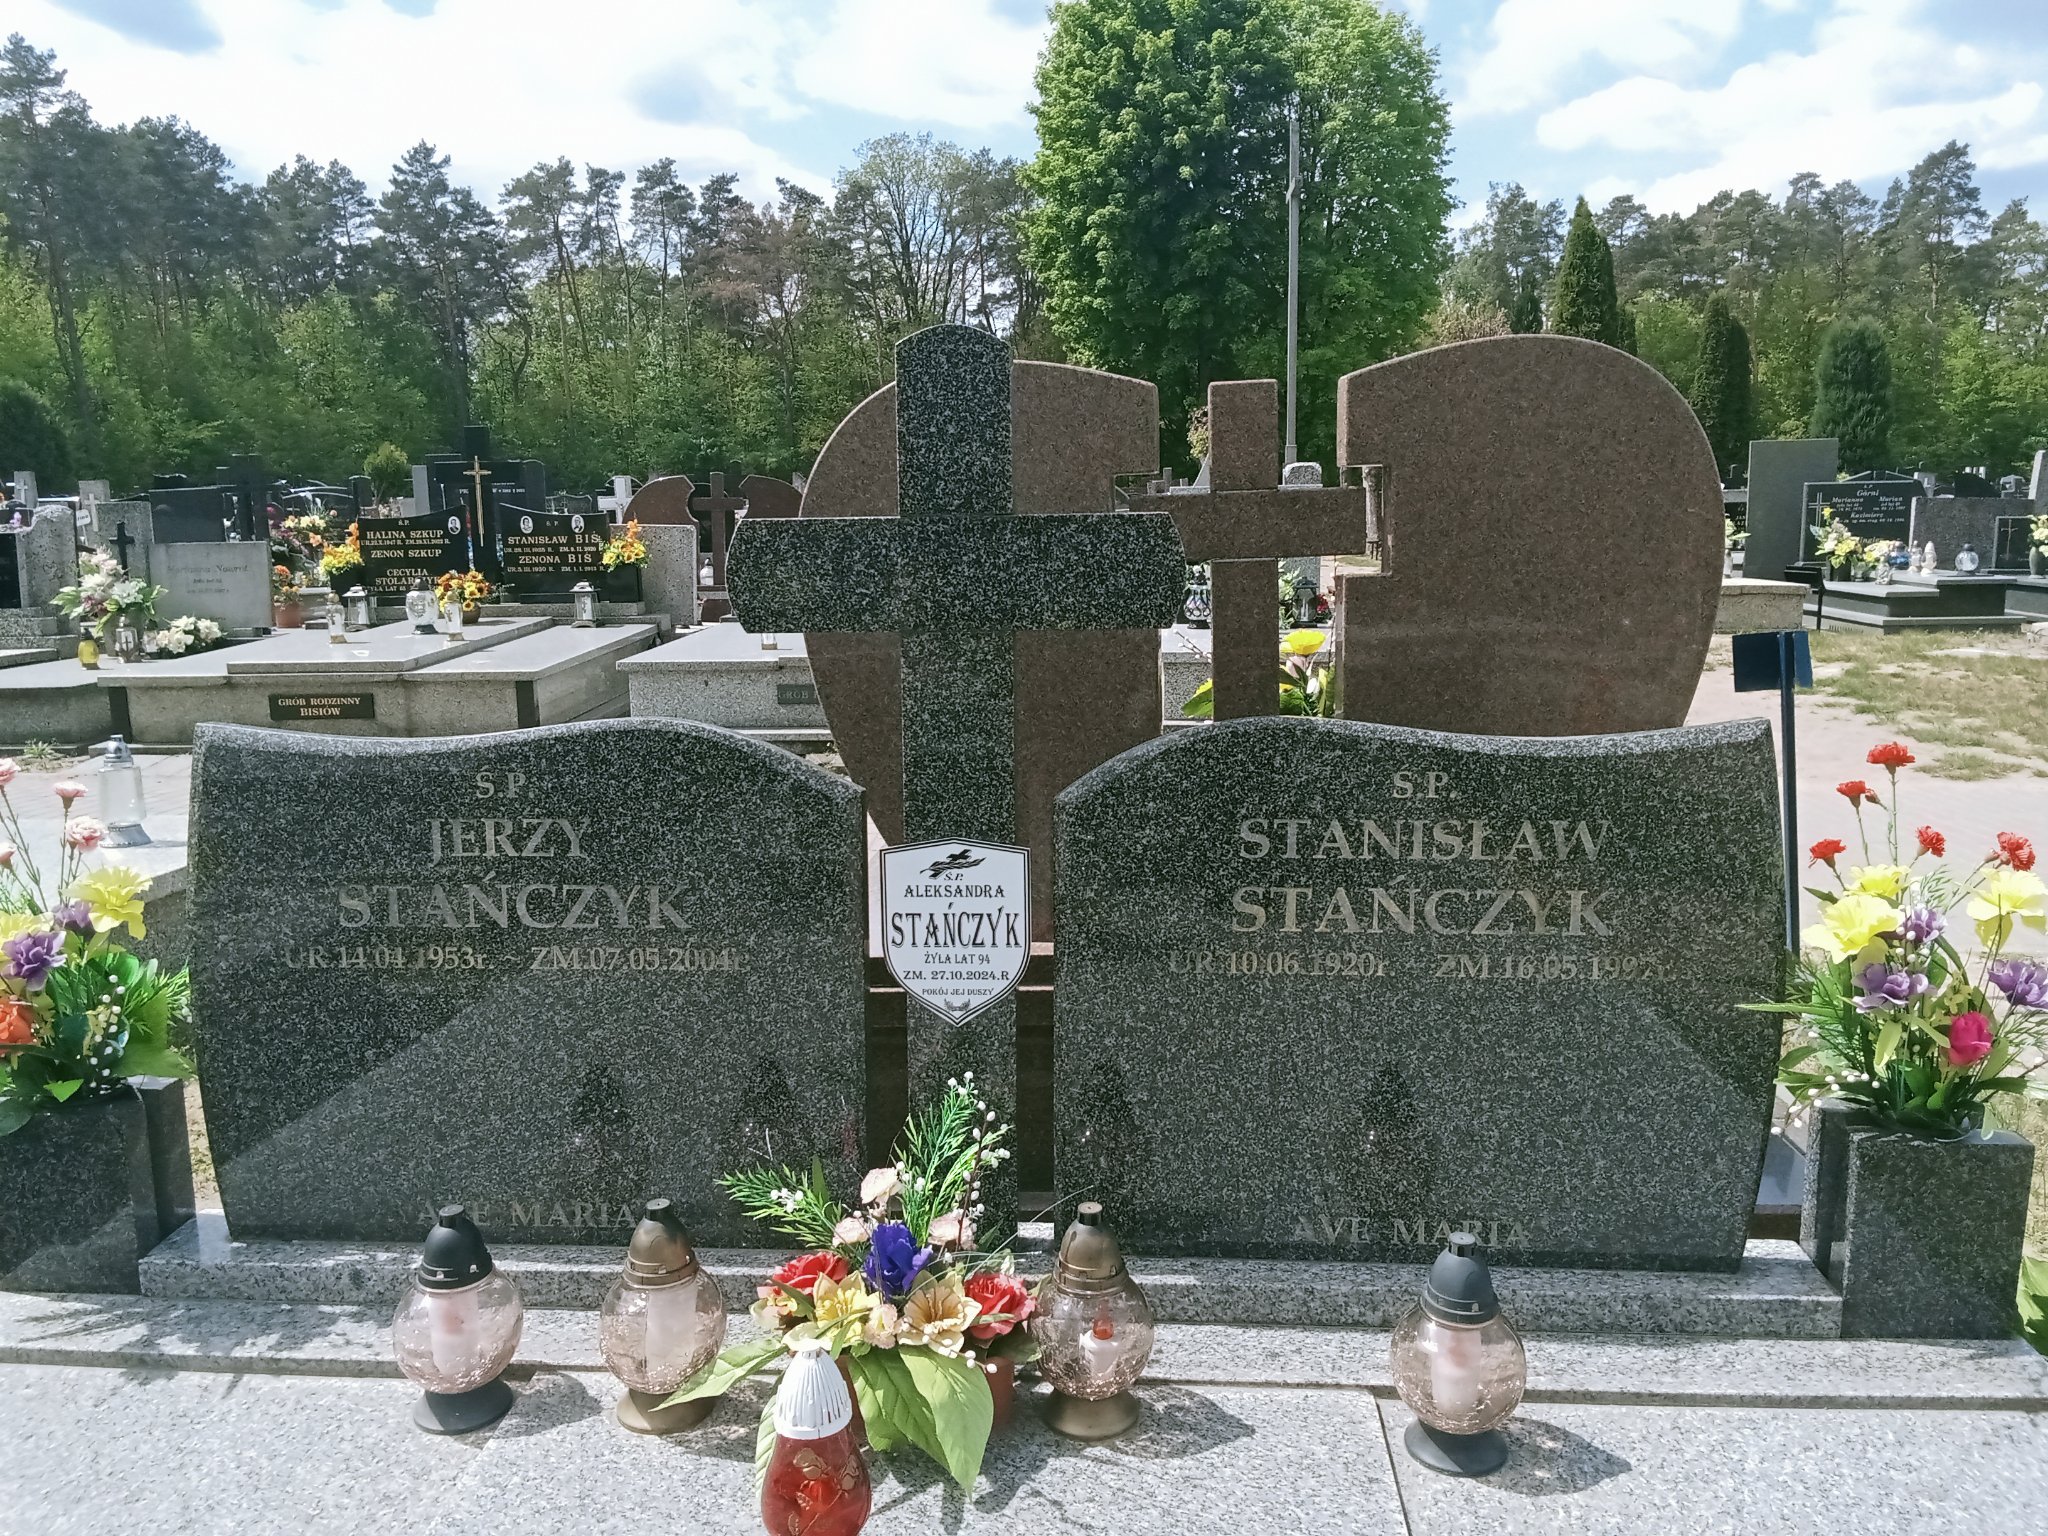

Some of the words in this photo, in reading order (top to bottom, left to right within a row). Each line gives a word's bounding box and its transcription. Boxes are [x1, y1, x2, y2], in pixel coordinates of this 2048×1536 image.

[366, 531, 406, 540] HALINA
[410, 530, 444, 539] SZKUP
[508, 535, 568, 545] STANISŁAW
[575, 531, 599, 544] BIŚ
[371, 549, 404, 558] ZENON
[408, 549, 442, 558] SZKUP
[519, 555, 560, 564] ZENONA
[568, 552, 592, 563] BIŚ
[386, 568, 429, 577] CECYLIA
[375, 576, 440, 586] STOLARYK
[278, 696, 306, 706] GRÓB
[310, 697, 361, 706] RODZINNY
[300, 706, 341, 716] BISIÓW
[1391, 765, 1461, 799] Ś.P.
[426, 817, 592, 867] JERZY
[1239, 818, 1610, 861] STANISŁAW
[943, 872, 964, 881] Ś.P.
[904, 885, 1006, 899] ALEKSANDRA
[336, 871, 694, 929] STAŃCZYK
[1232, 874, 1614, 937] STAŃCZYK
[891, 901, 1022, 948] STAŃCZYK
[924, 950, 951, 964] ŻYŁA
[954, 953, 975, 964] LAT
[978, 953, 990, 964] 94
[903, 970, 927, 981] ZM.
[922, 986, 949, 996] POKÓJ
[950, 988, 965, 996] JEJ
[967, 987, 994, 996] DUSZY
[417, 1200, 491, 1226] AE
[511, 1201, 637, 1227] MARIA
[1297, 1213, 1371, 1245] AVE
[1391, 1215, 1529, 1248] MARIA
